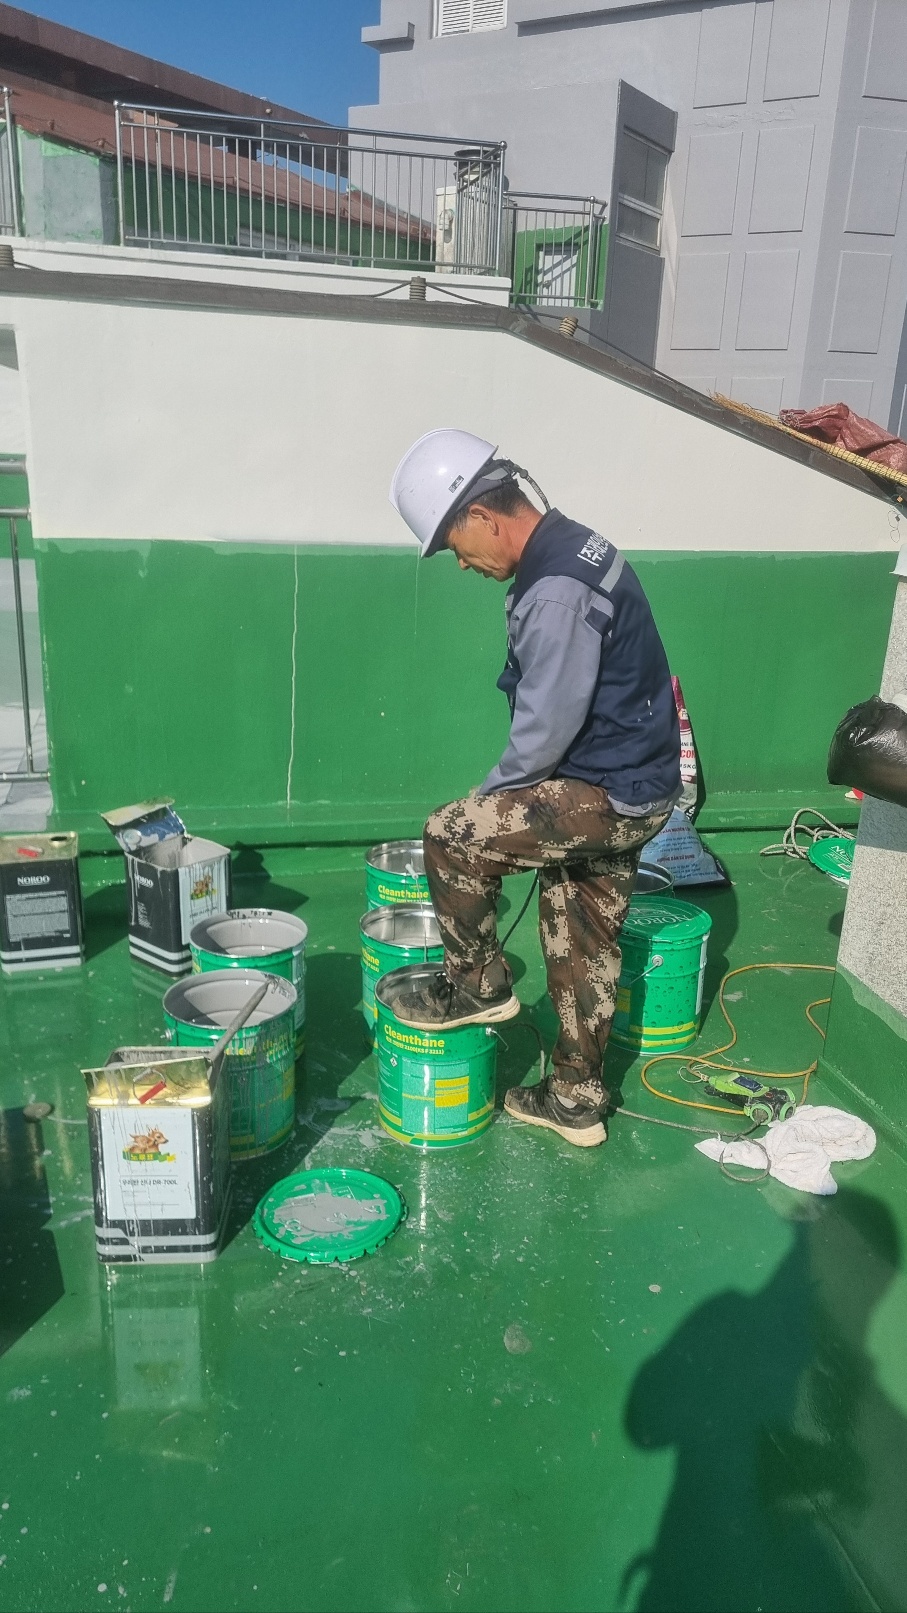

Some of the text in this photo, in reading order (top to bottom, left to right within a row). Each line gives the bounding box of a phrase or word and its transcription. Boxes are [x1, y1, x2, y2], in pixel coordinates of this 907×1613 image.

[17, 875, 50, 887] NOROO
[378, 885, 429, 899] Cleanthane
[384, 1024, 445, 1048] Cleanthane
